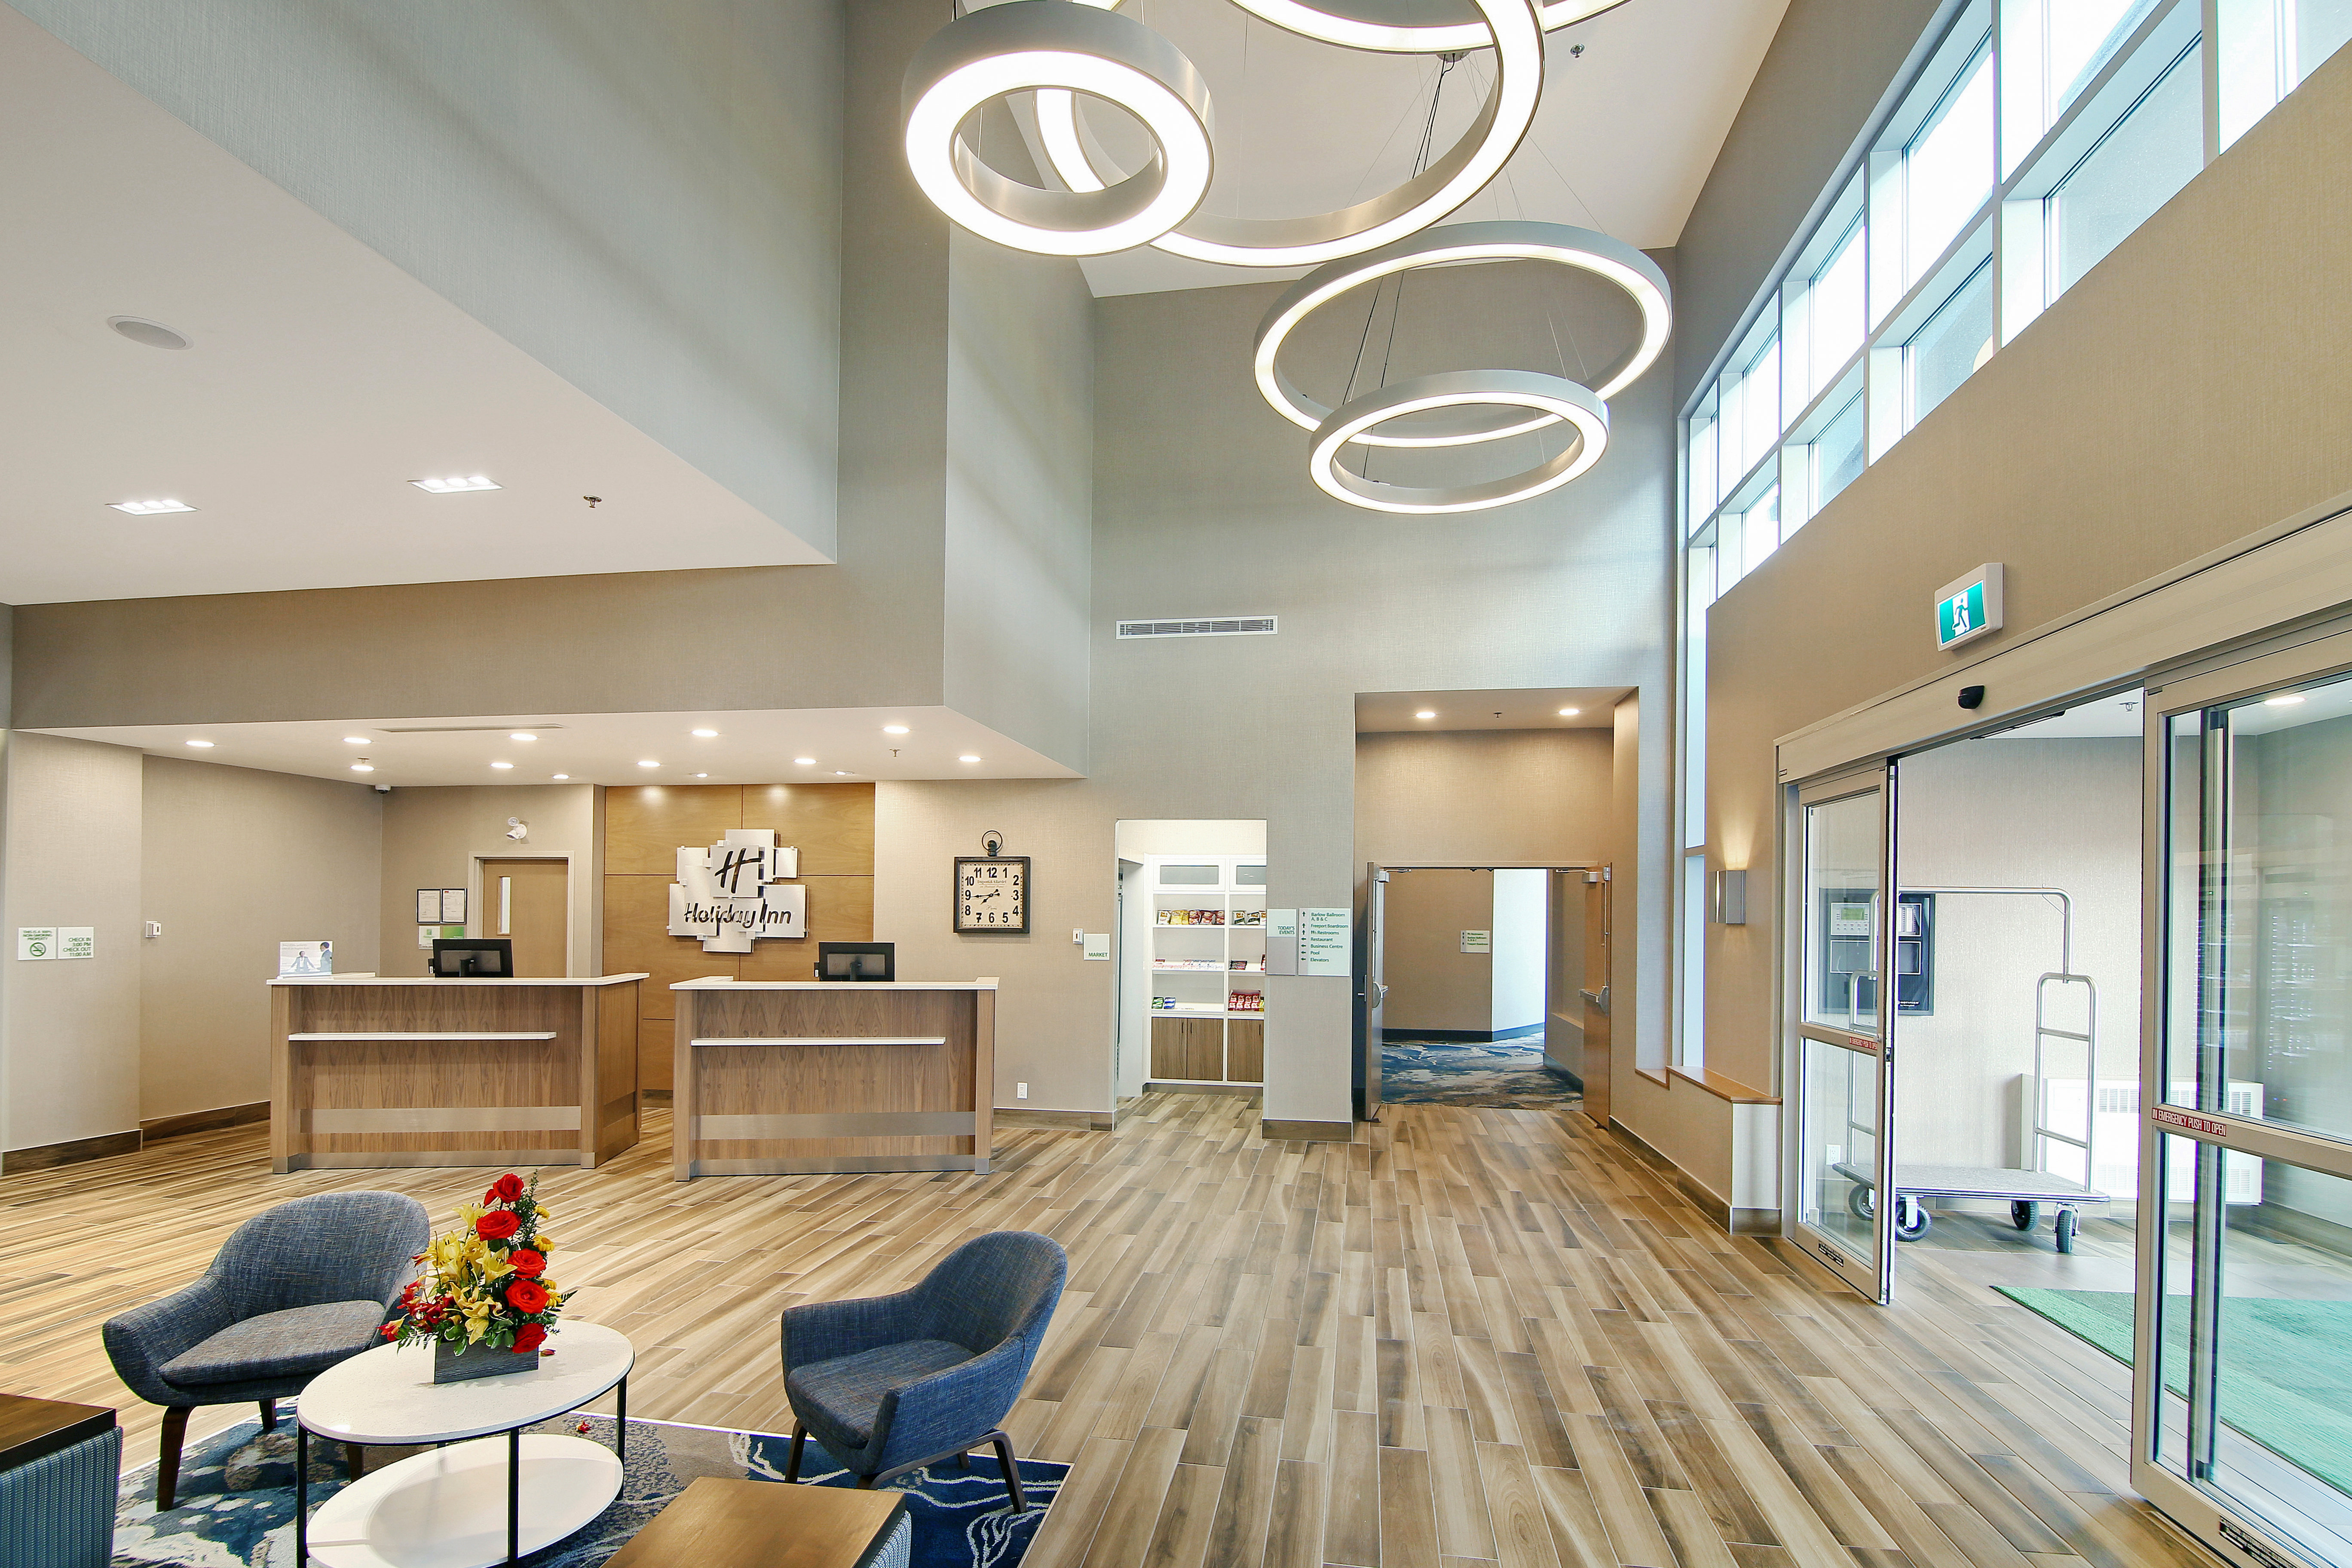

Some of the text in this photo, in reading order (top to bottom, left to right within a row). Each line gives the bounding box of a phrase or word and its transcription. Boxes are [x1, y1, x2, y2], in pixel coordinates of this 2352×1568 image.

[974, 867, 982, 878] 11
[986, 867, 997, 878] 12
[1002, 867, 1008, 878] 1
[965, 876, 974, 886] 10
[1013, 875, 1019, 886] 2
[965, 890, 971, 900] 9
[1013, 890, 1019, 900] 3
[683, 903, 793, 928] Holiday Inn
[965, 905, 971, 916] 8
[1012, 905, 1019, 916] 4
[976, 913, 982, 923] 7
[989, 913, 995, 923] 6
[1002, 913, 1008, 923] 5
[2152, 1109, 2226, 1136] IN EMERGENCY PUSH TO OPEN
